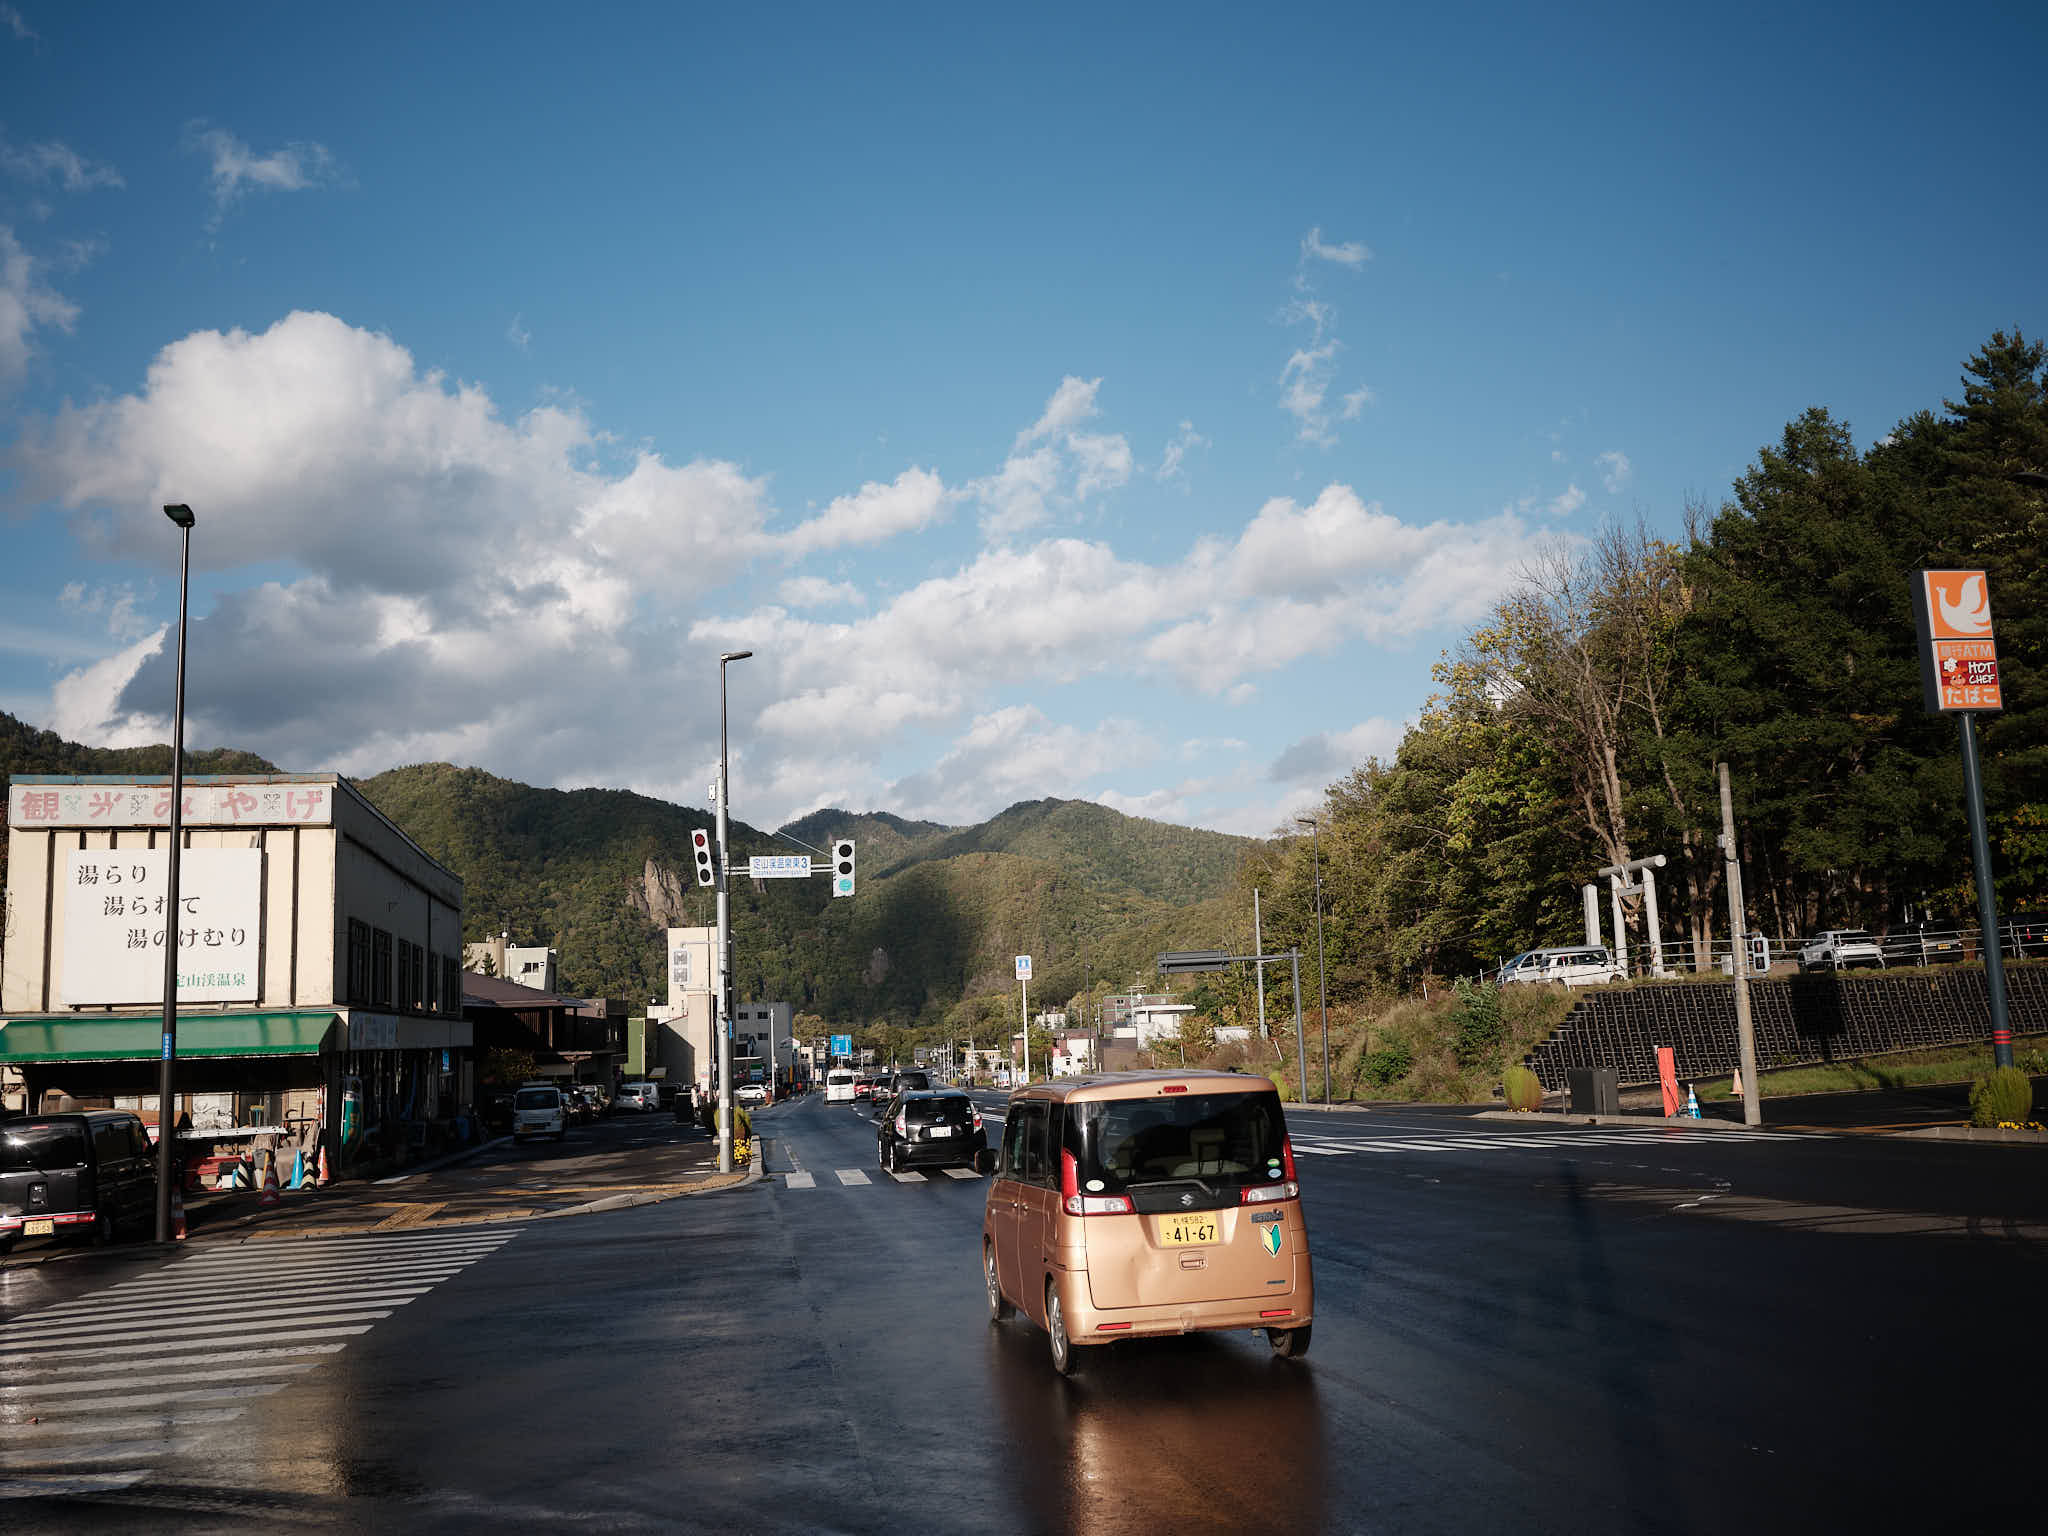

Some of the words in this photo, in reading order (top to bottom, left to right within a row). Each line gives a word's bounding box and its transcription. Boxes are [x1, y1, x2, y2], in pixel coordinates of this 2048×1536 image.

[1968, 661, 1995, 675] HOT
[1968, 674, 1996, 685] CHEF
[1946, 687, 1998, 705] たばこ
[78, 864, 147, 886] 湯らり
[103, 895, 201, 917] 湯られて
[127, 927, 246, 949] 湯のけむり
[1174, 1225, 1214, 1242] 41-67
